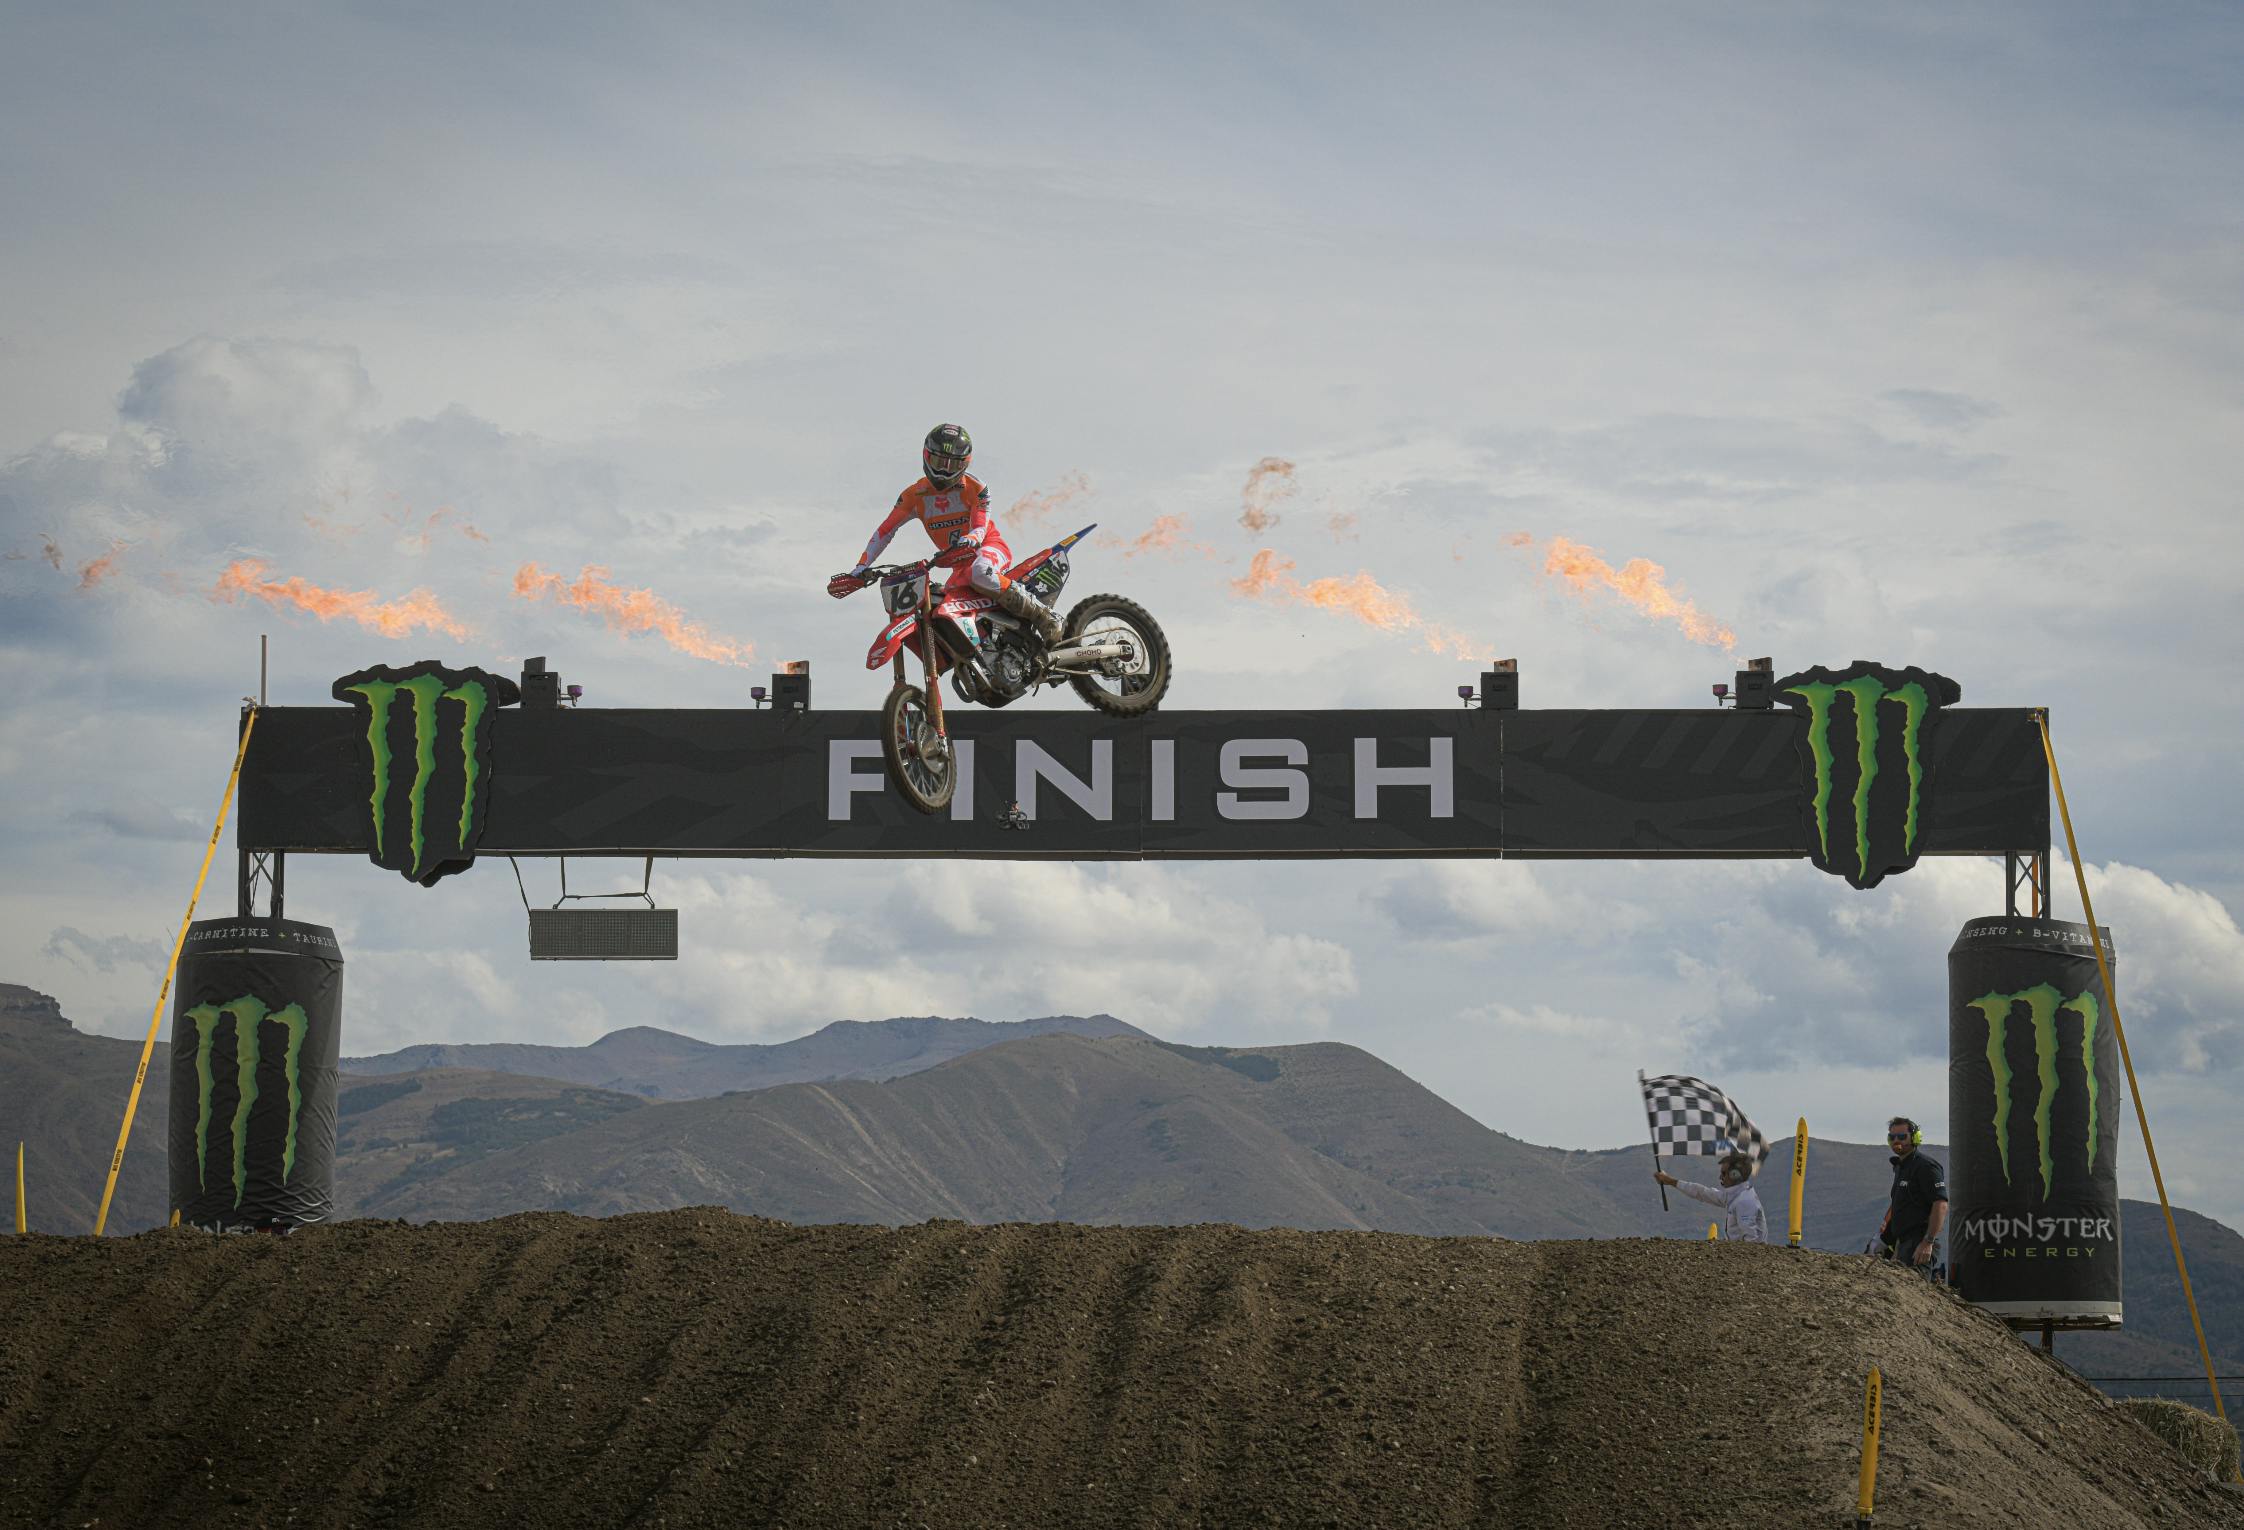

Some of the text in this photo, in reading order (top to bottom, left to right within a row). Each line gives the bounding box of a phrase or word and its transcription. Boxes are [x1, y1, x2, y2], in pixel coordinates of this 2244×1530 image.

[929, 516, 970, 529] HONDA
[890, 581, 918, 613] 16
[943, 598, 998, 613] HOND
[828, 737, 1454, 821] FINISH
[1965, 1212, 2114, 1244] MONSTER
[1984, 1247, 2095, 1258] ENERGY
